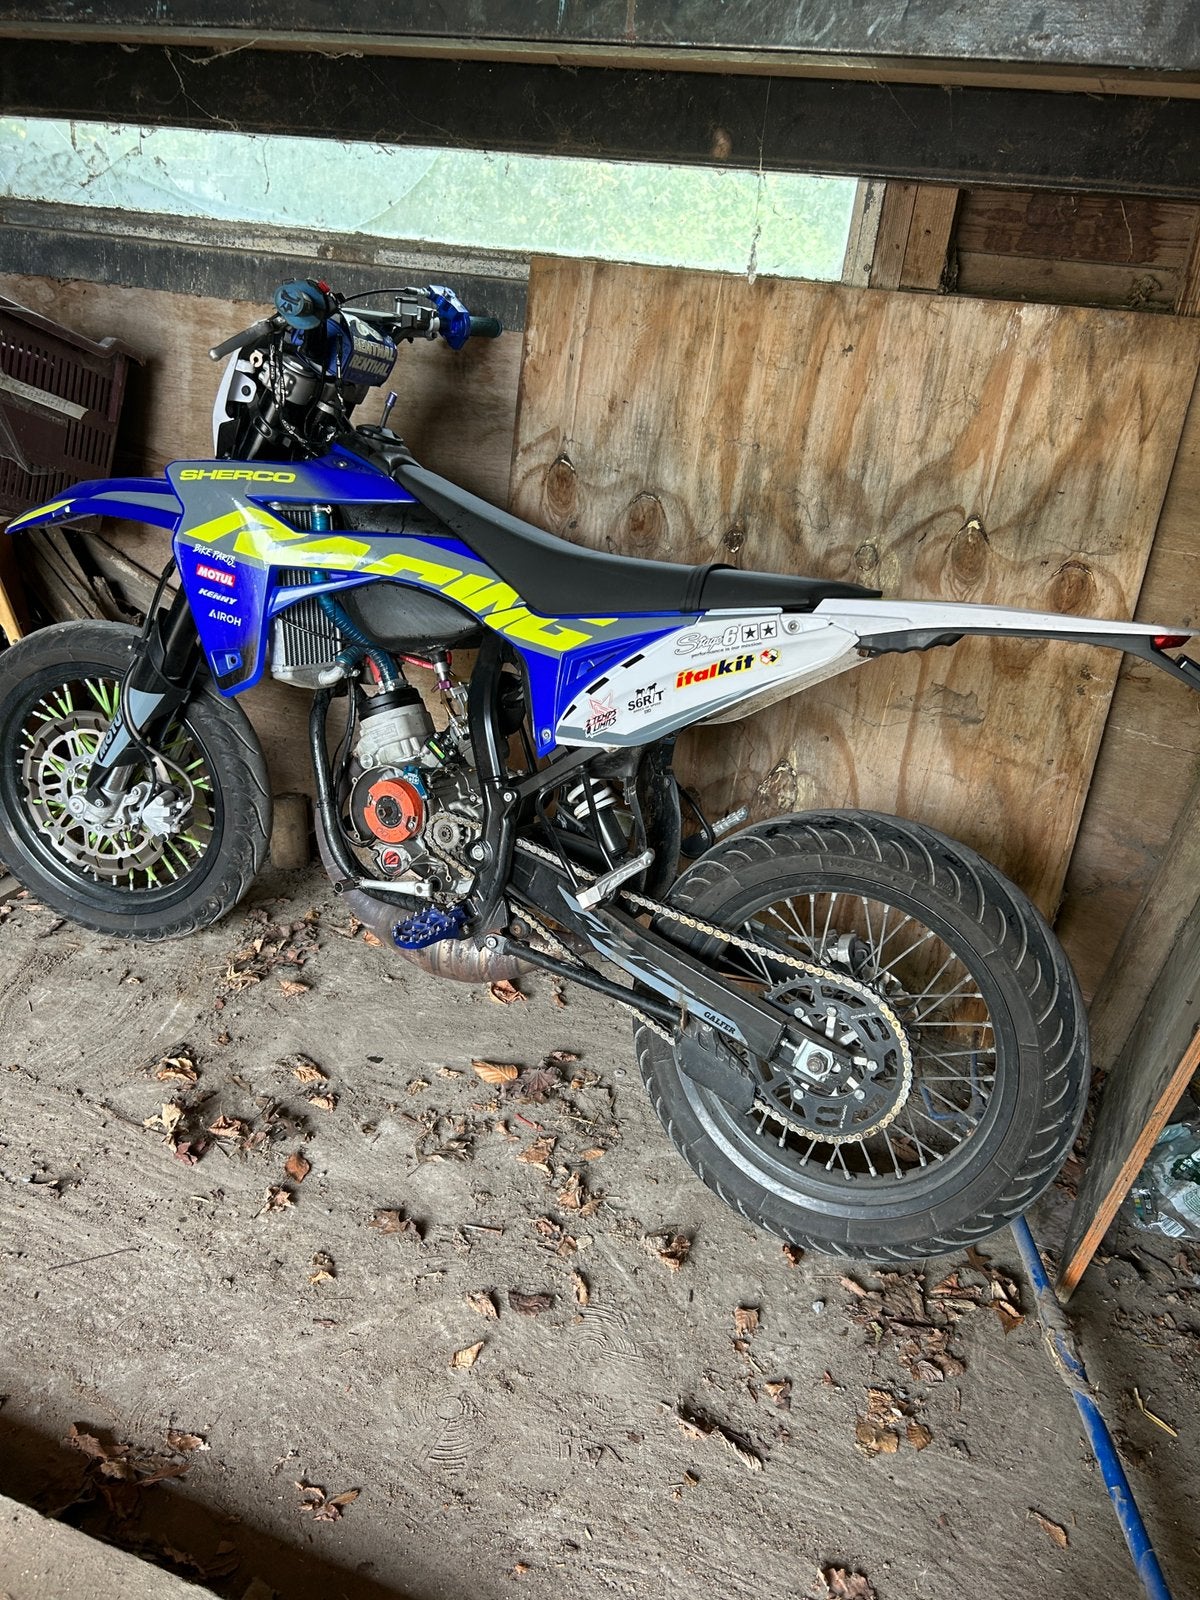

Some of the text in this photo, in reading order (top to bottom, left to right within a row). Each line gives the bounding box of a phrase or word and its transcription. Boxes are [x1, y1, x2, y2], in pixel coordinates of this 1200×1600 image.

[352, 336, 395, 361] RENTHAL
[349, 354, 390, 376] RENTHAL
[179, 469, 297, 484] SHERCO
[197, 566, 234, 586] MOTUL
[198, 588, 237, 605] KENNY
[208, 609, 242, 627] AIROH
[676, 654, 755, 688] italkit
[98, 708, 124, 763] MOTU
[703, 1011, 736, 1035] GALFER
